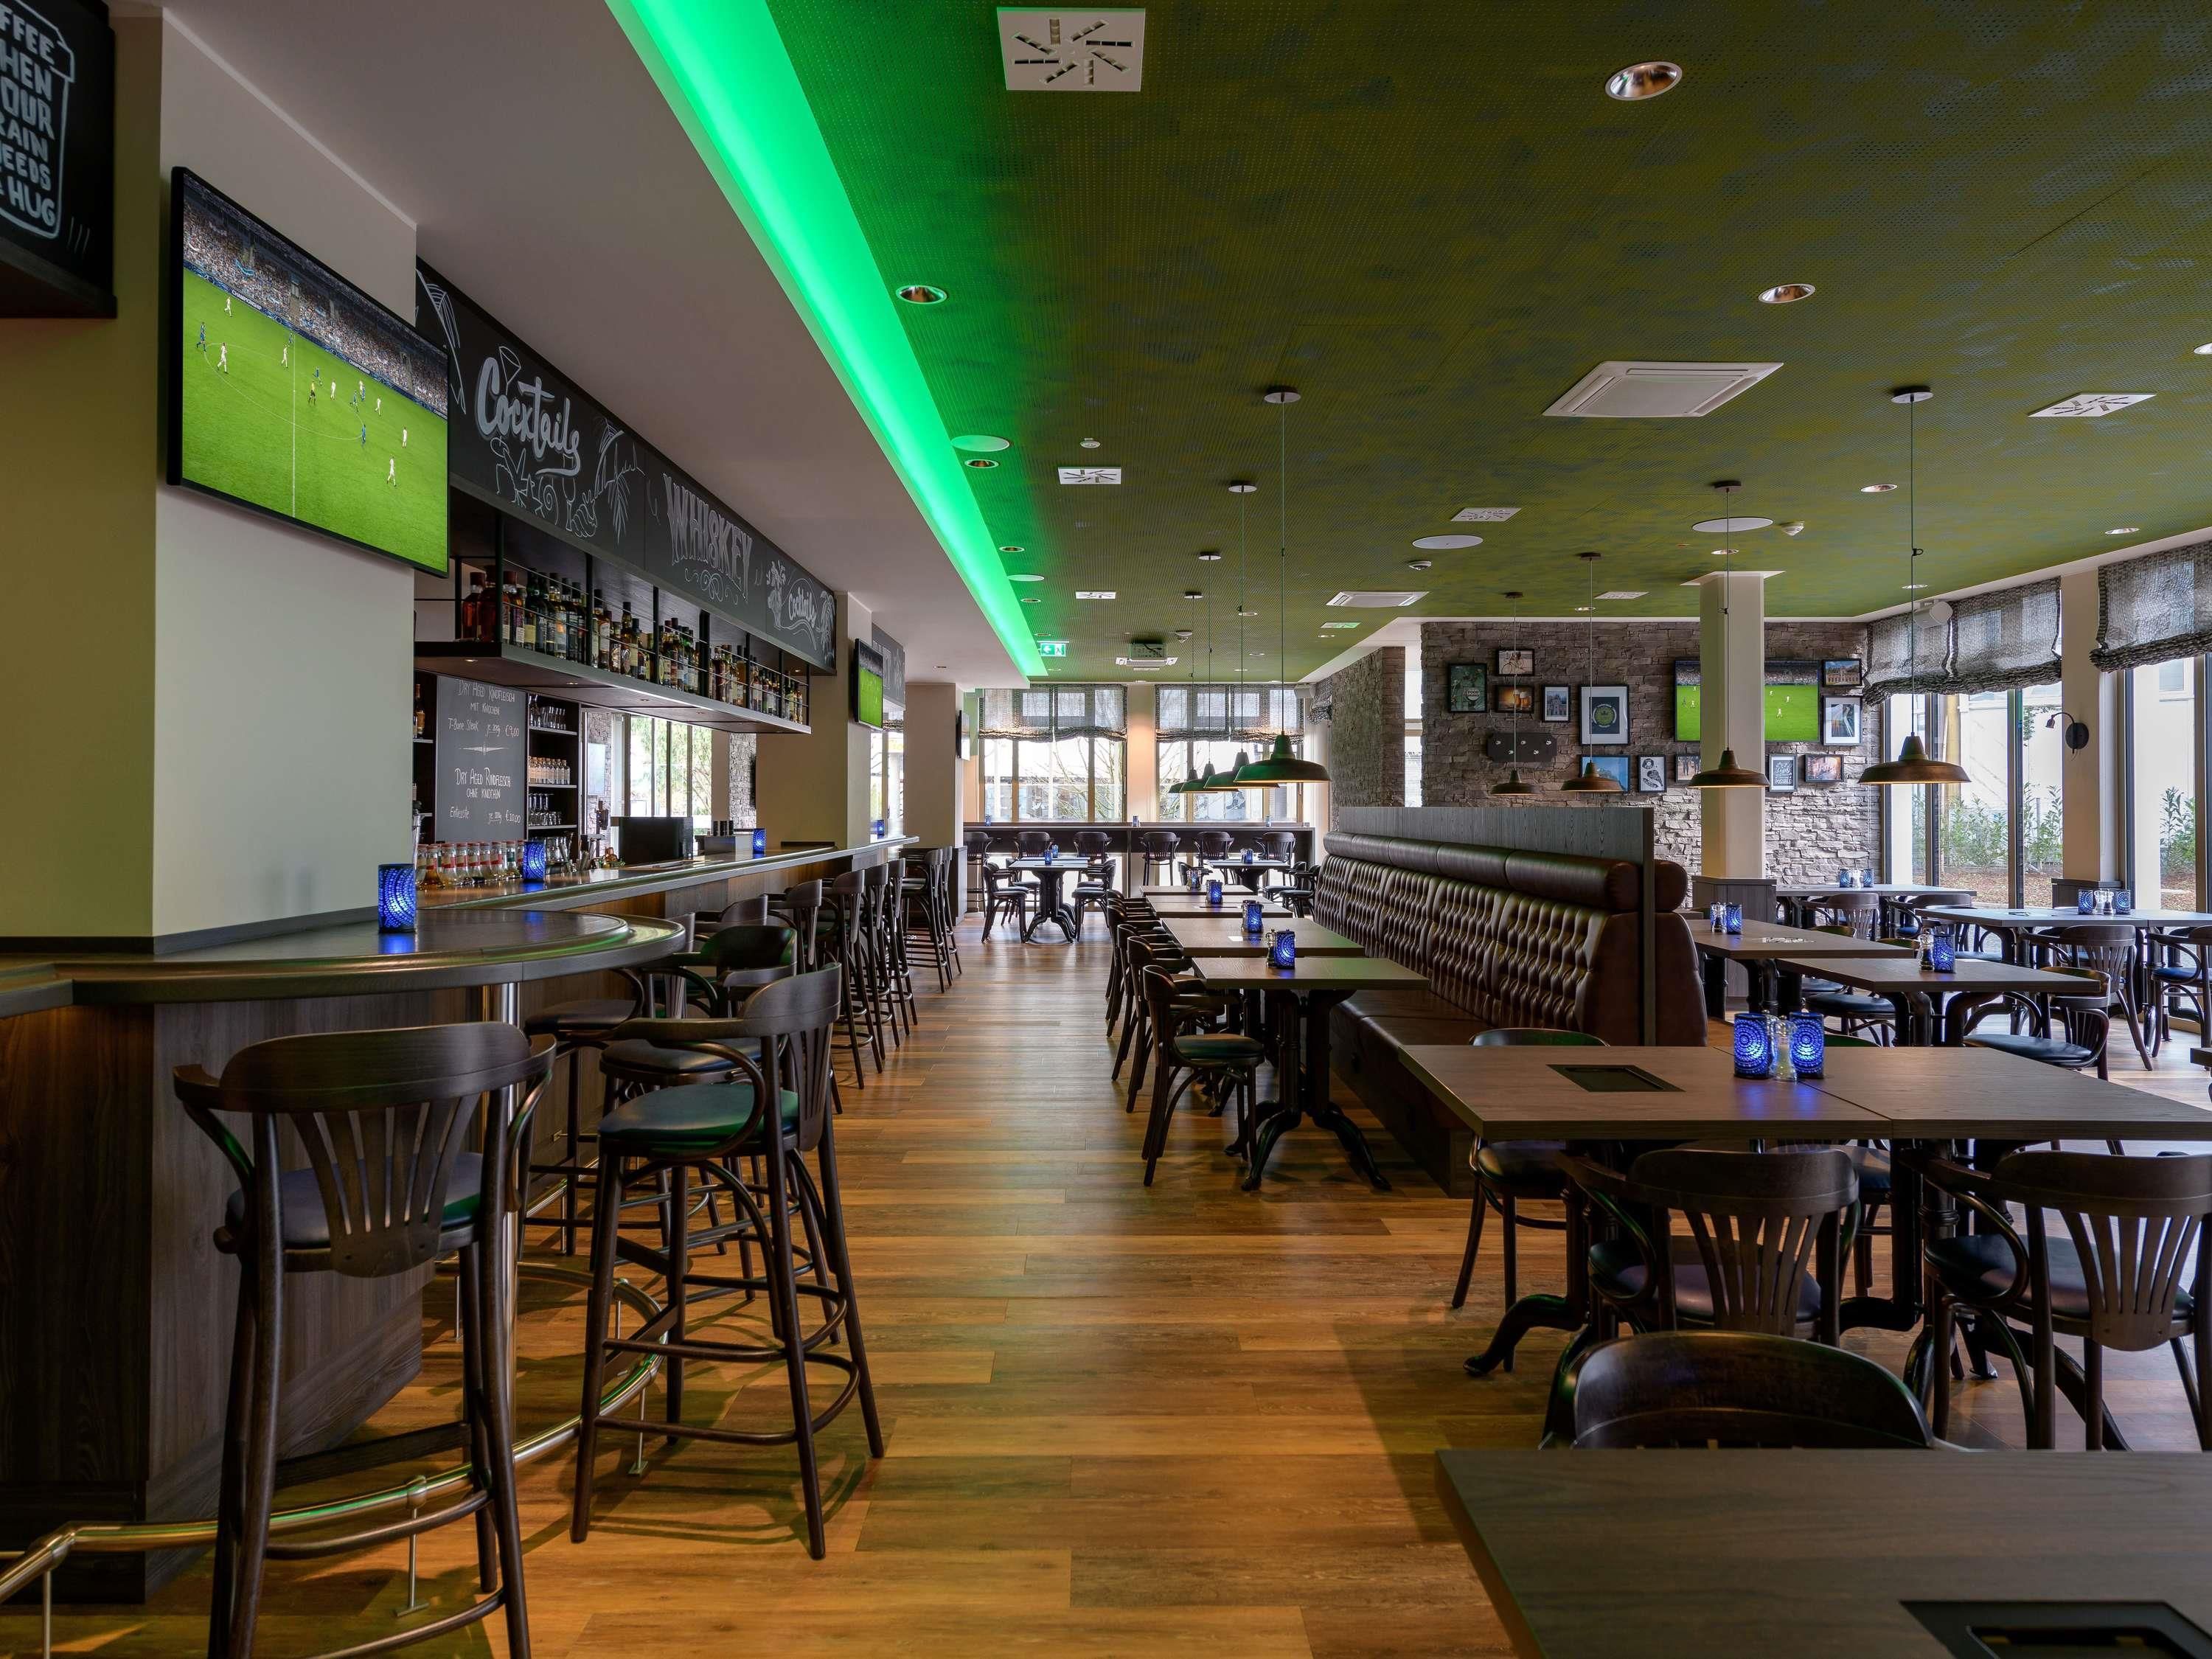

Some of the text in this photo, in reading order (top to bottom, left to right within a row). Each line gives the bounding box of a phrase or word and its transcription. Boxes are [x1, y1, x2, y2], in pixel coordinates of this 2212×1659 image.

[7, 175, 56, 227] HUG
[663, 473, 753, 603] WHISKEY
[788, 586, 817, 629] Cocktails
